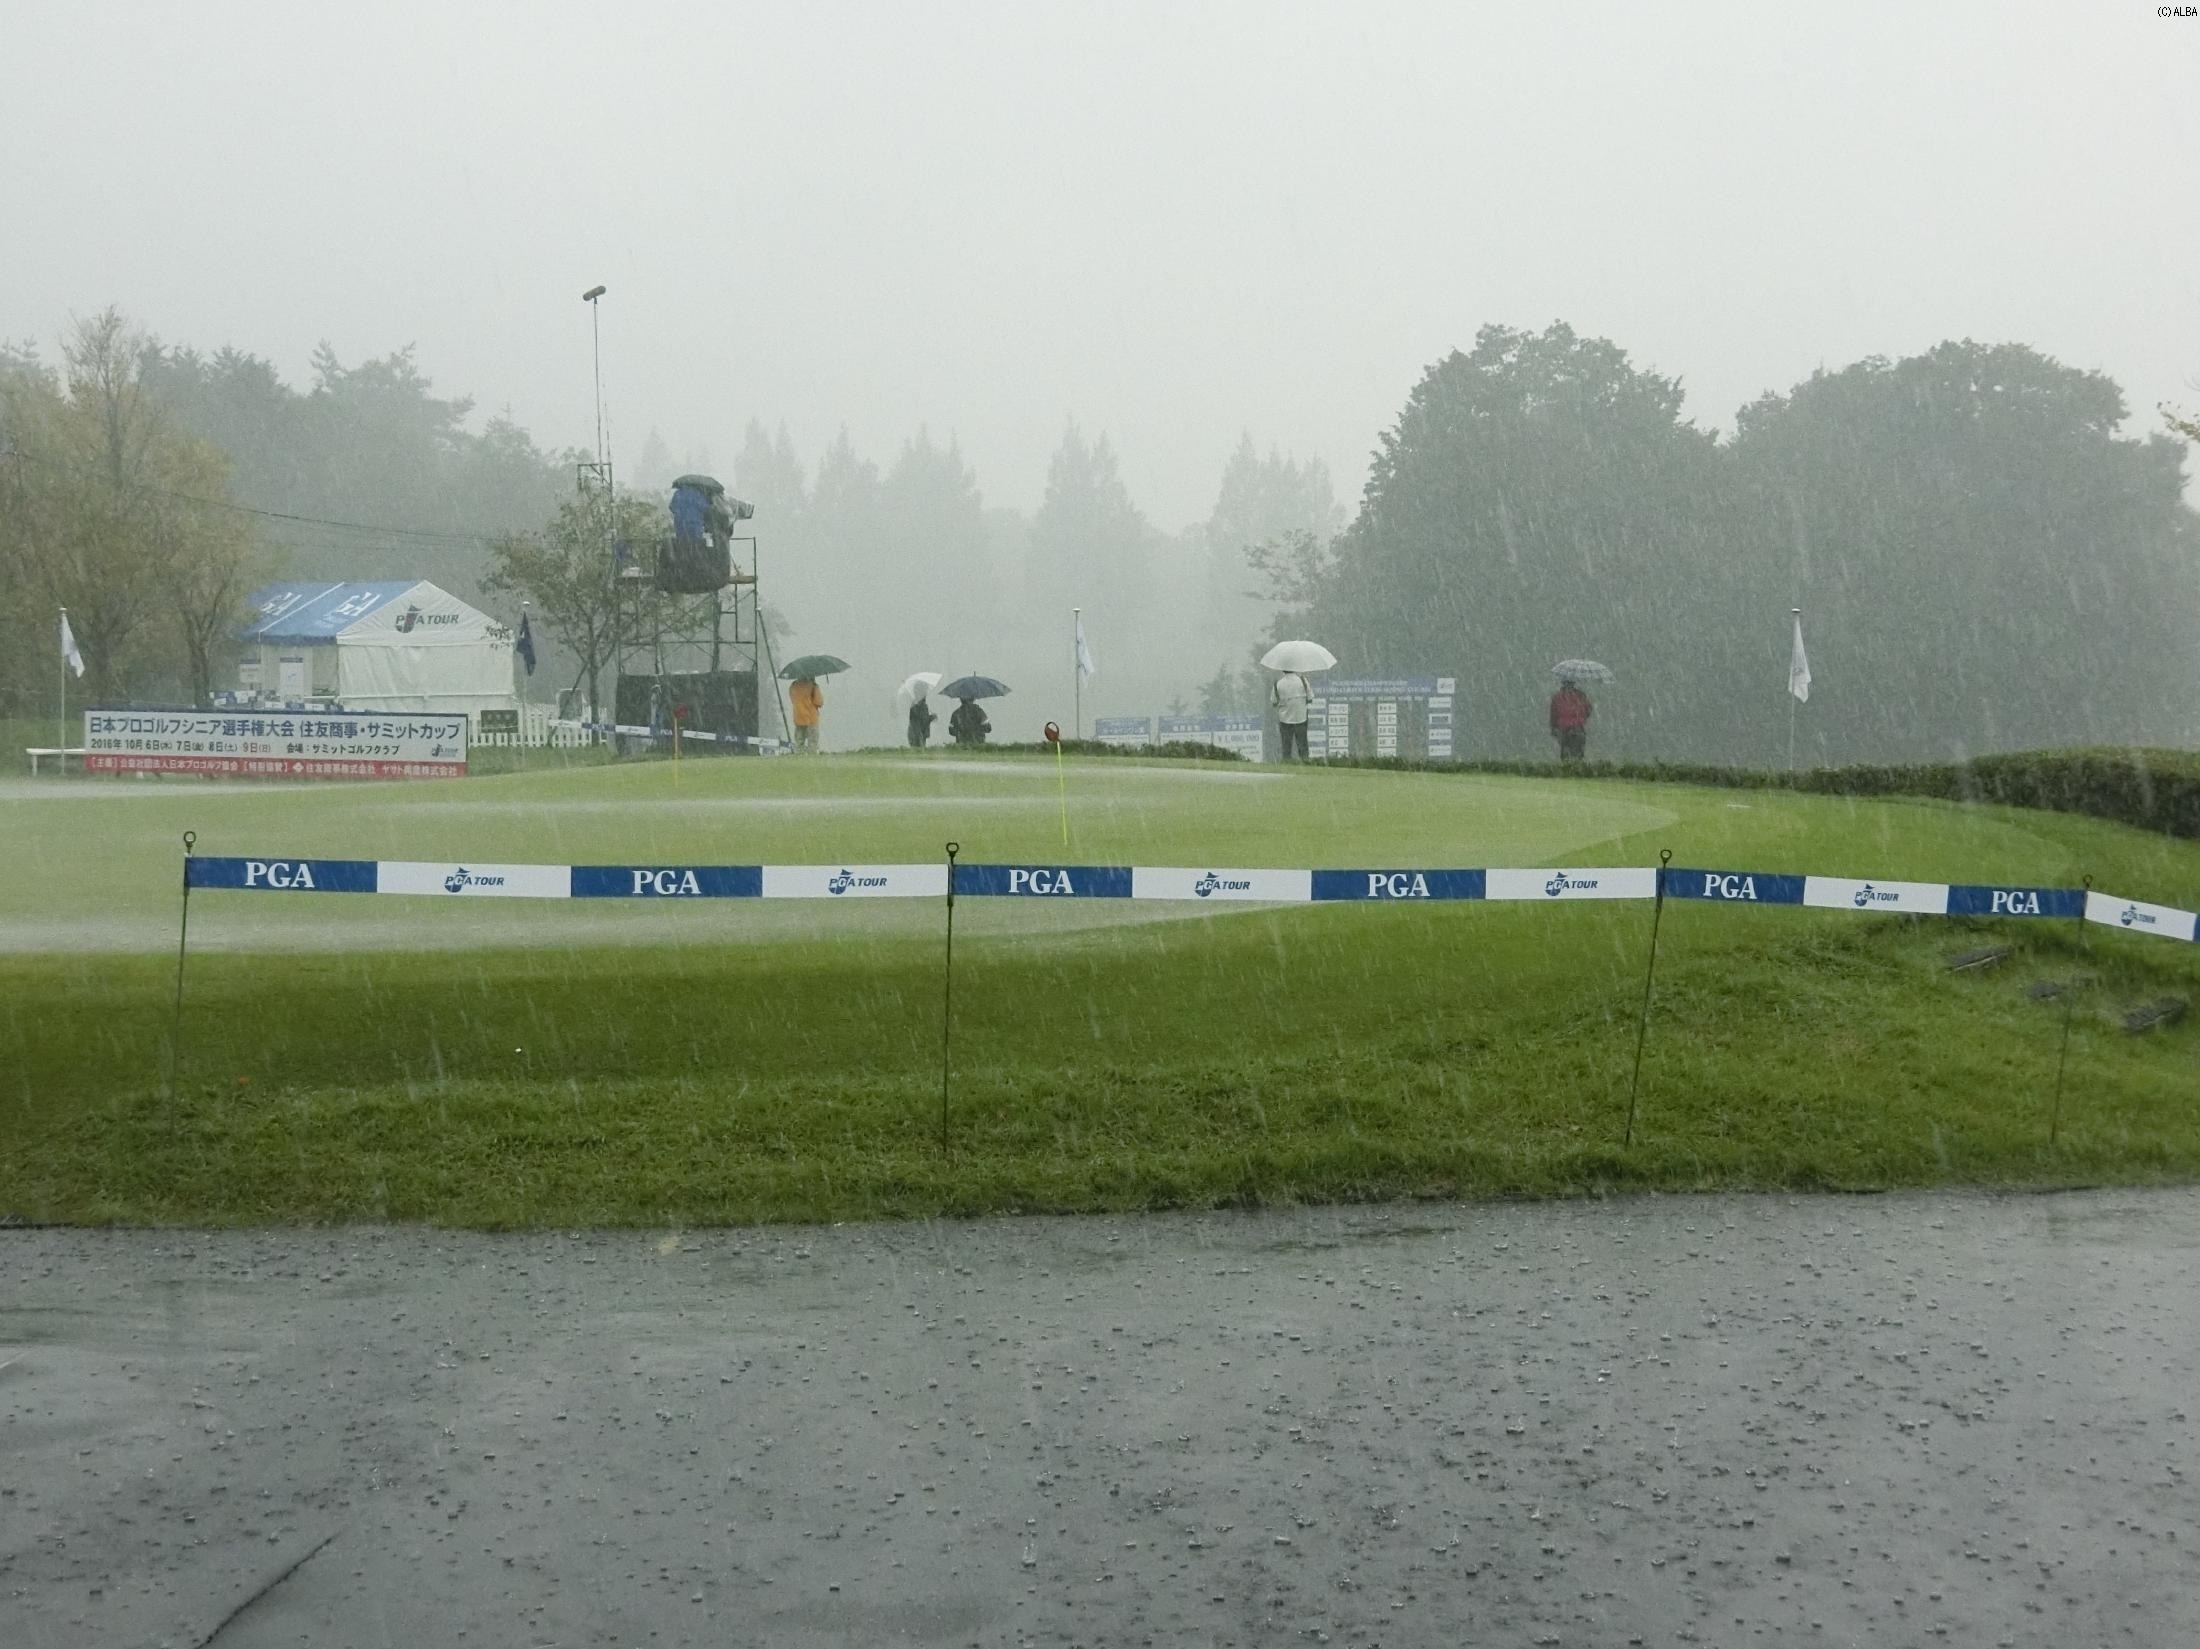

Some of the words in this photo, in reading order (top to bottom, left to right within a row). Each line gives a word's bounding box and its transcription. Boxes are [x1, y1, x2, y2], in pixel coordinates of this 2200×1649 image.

[427, 613, 459, 625] TOUR
[90, 716, 295, 738] 日本プロゴルフシニア選手権大会
[300, 720, 461, 740] 住友商事・サミットカップ
[245, 861, 315, 889] PGA
[474, 876, 505, 886] TOUR
[632, 870, 701, 895] PGA
[857, 877, 887, 887] TOUR
[1008, 869, 1075, 894] PGA
[1221, 880, 1251, 890] TOUR
[1367, 873, 1431, 898] PGA
[1571, 879, 1598, 889] TOUR
[1702, 873, 1758, 900] PGA
[1877, 892, 1899, 902] TOUR
[1991, 890, 2041, 915] PGA
